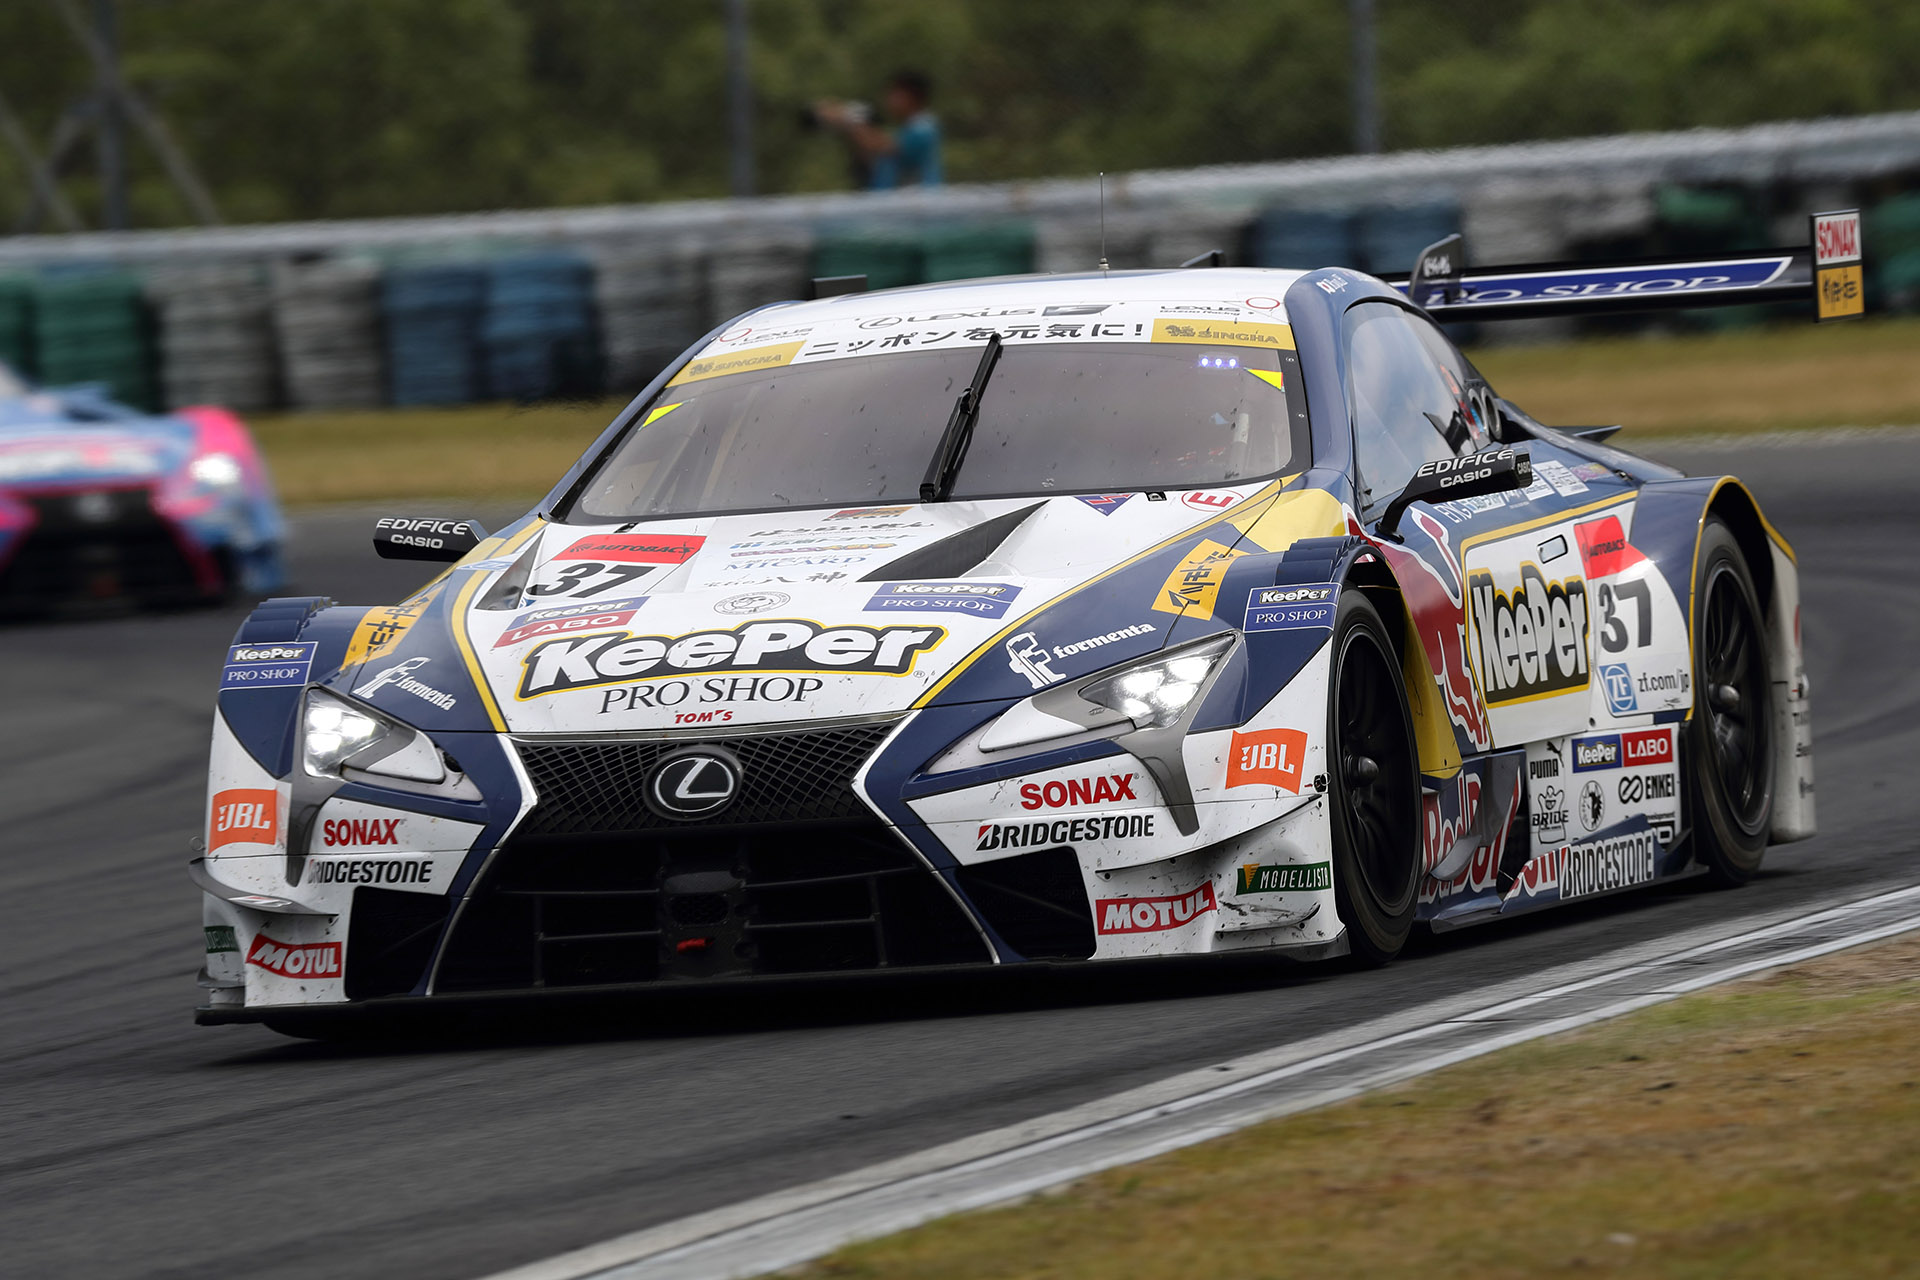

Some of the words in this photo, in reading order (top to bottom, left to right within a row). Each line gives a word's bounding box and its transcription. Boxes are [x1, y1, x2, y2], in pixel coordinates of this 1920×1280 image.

[1818, 219, 1858, 258] SONAX
[1534, 275, 1731, 299] SHOP
[907, 307, 1036, 322] LEXUS
[1198, 331, 1280, 344] SINGHA
[1416, 449, 1515, 478] EDIFICE
[1439, 467, 1492, 489] CASIO
[376, 518, 470, 536] EDIFICE
[390, 533, 444, 549] CASIO
[594, 543, 696, 555] AUTOBACS
[525, 562, 657, 598] 37
[892, 583, 1007, 596] KeePer
[881, 598, 931, 607] PRO
[932, 599, 994, 612] SHOP
[1259, 587, 1332, 604] KeePer
[525, 600, 634, 624] KeePer
[1255, 612, 1286, 624] PRO
[1287, 608, 1328, 621] SHOP
[1597, 578, 1652, 653] 37
[510, 615, 620, 641] LABO
[1053, 623, 1157, 659] formenta
[1470, 570, 1588, 697] KeePer
[233, 647, 305, 662] KeePer
[522, 620, 947, 698] KeePer
[227, 670, 257, 682] PRO
[259, 668, 300, 680] SHOP
[1606, 673, 1634, 702] ZF
[1637, 667, 1690, 694] zf.com/jp
[395, 675, 458, 712] formenta
[599, 676, 690, 714] PRO
[699, 675, 823, 709] SHOP
[674, 709, 734, 725] TOM'S
[1240, 742, 1295, 775] JBL
[1576, 743, 1618, 766] KeePer
[1627, 737, 1669, 759] LABO
[1530, 758, 1560, 780] PUMA
[1020, 772, 1137, 810] SONAX
[1645, 773, 1676, 800] ENKEI
[217, 802, 271, 832] JBL
[1532, 809, 1569, 827] BRIDE
[323, 818, 401, 847] SONAX
[976, 814, 1155, 851] BRIDGESTONE
[1560, 835, 1654, 899] BRIDGESTONE
[1102, 888, 1210, 930] MOTUL
[250, 942, 338, 974] MOTUL
